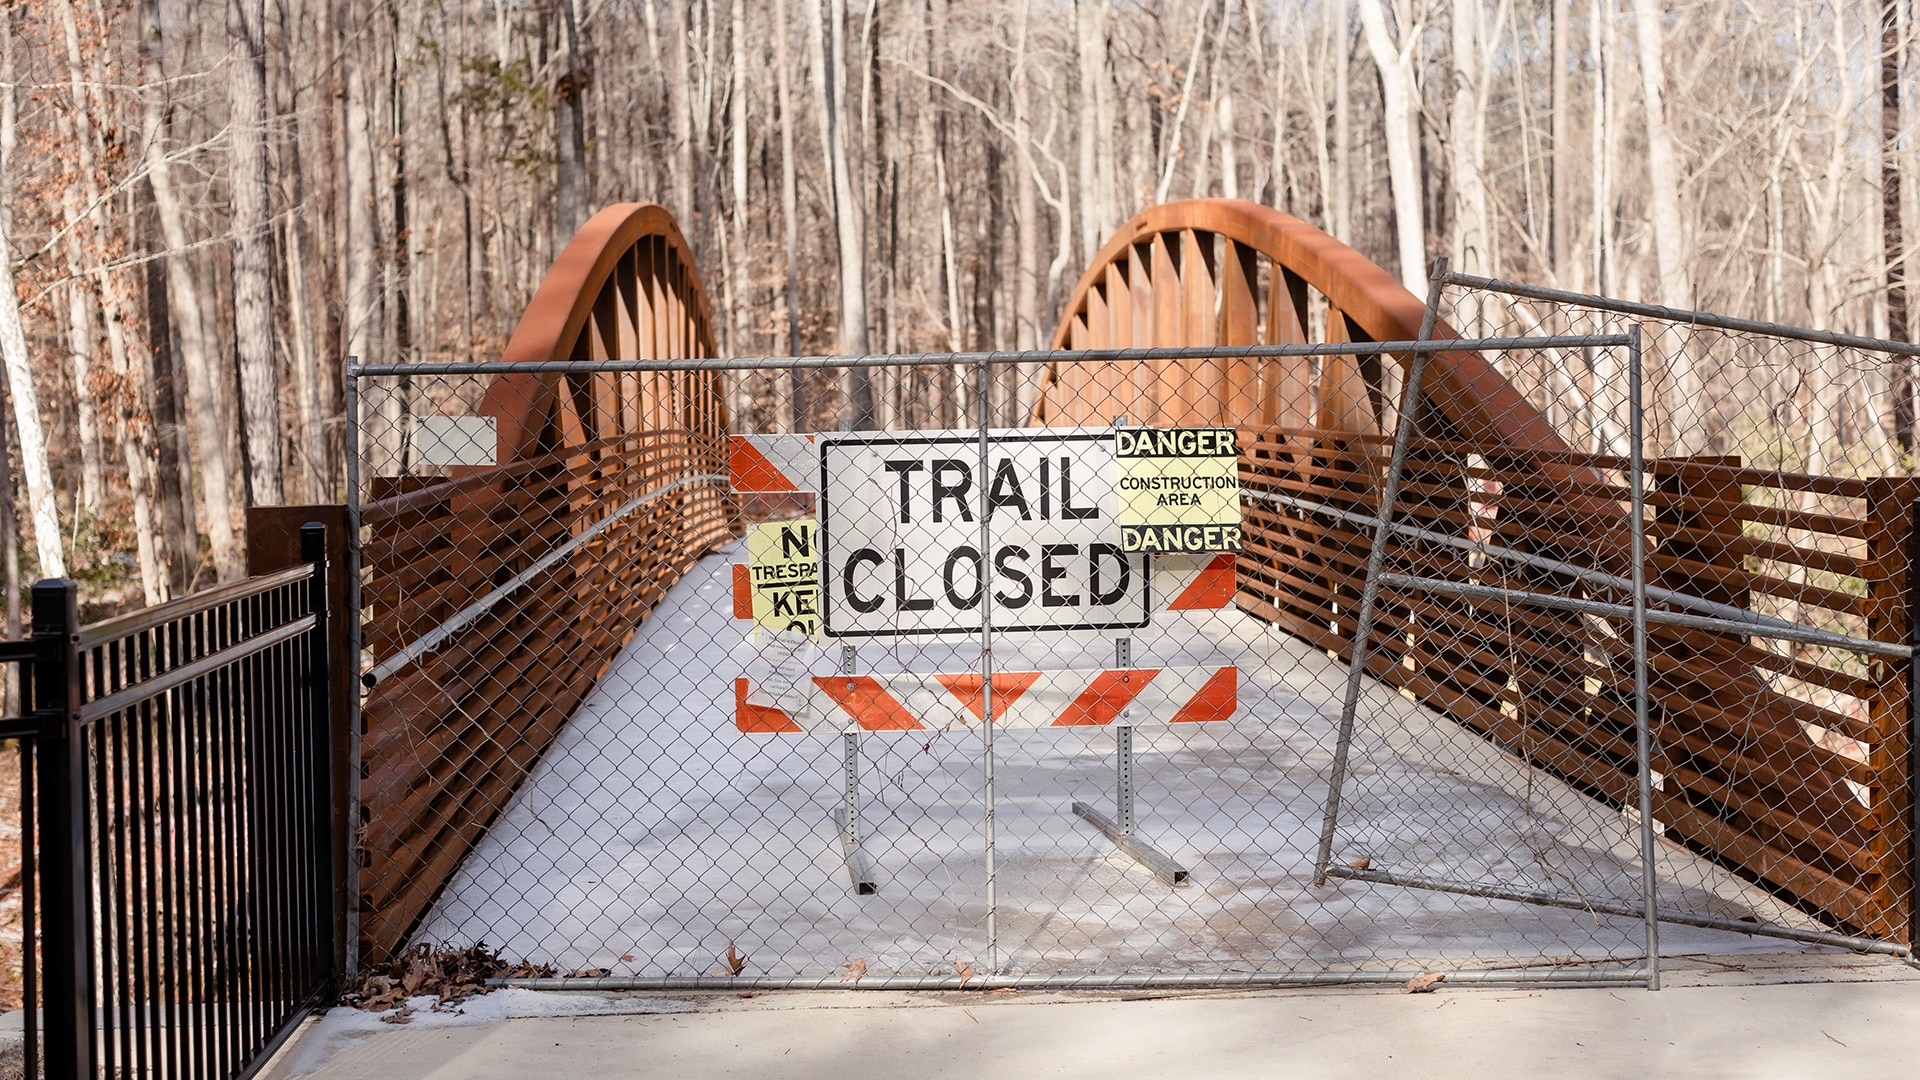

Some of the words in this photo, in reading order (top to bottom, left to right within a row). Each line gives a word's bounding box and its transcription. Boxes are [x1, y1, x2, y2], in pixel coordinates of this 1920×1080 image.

[1116, 430, 1235, 455] DANGER
[884, 456, 1099, 523] TRAIL
[1119, 476, 1236, 490] CONSTRUCTION
[1156, 493, 1202, 506] AREA
[781, 525, 817, 559] N
[1122, 526, 1242, 552] DANGER
[843, 542, 1130, 614] CLOSED
[773, 589, 819, 617] KE
